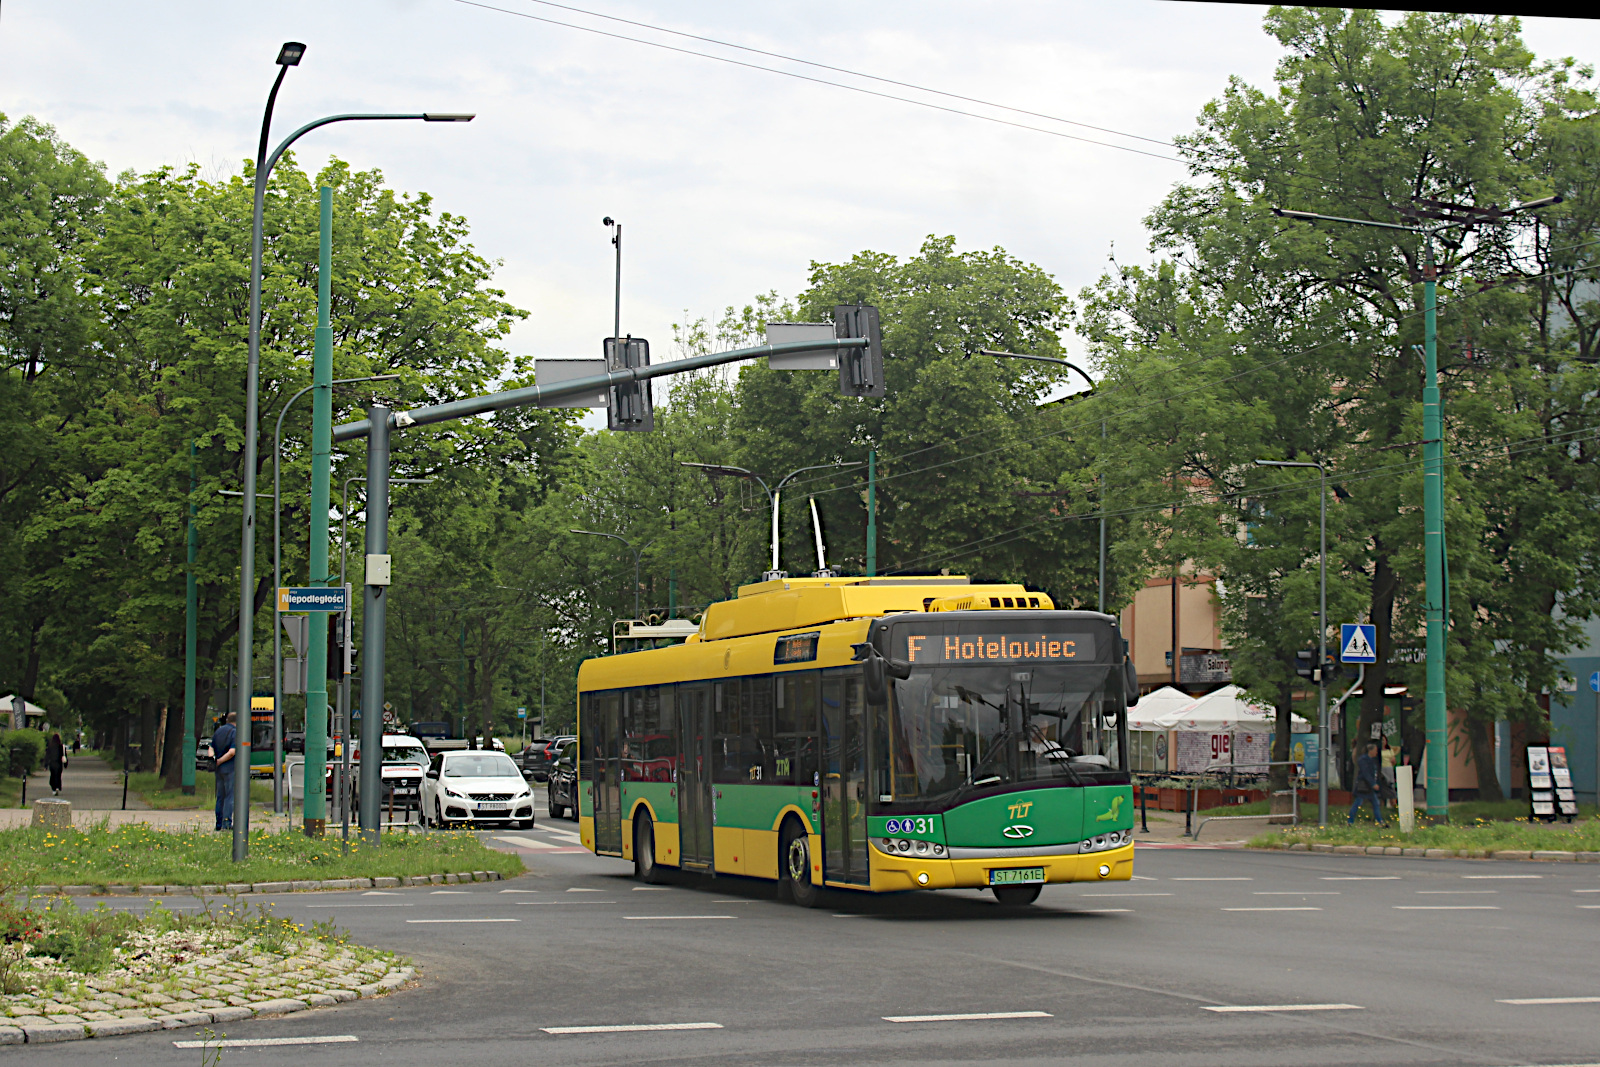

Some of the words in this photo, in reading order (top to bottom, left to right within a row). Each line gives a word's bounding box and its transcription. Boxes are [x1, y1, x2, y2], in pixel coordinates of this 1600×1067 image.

[281, 593, 344, 605] Niepodległości
[908, 635, 926, 662] F
[944, 635, 1076, 660] Hotelowiec
[1207, 657, 1224, 671] Salon
[756, 765, 762, 780] 31
[776, 757, 790, 776] ZTM
[1008, 801, 1033, 820] TLT
[915, 817, 934, 834] 31
[996, 871, 1009, 881] ST
[1012, 869, 1042, 881] 7161E
